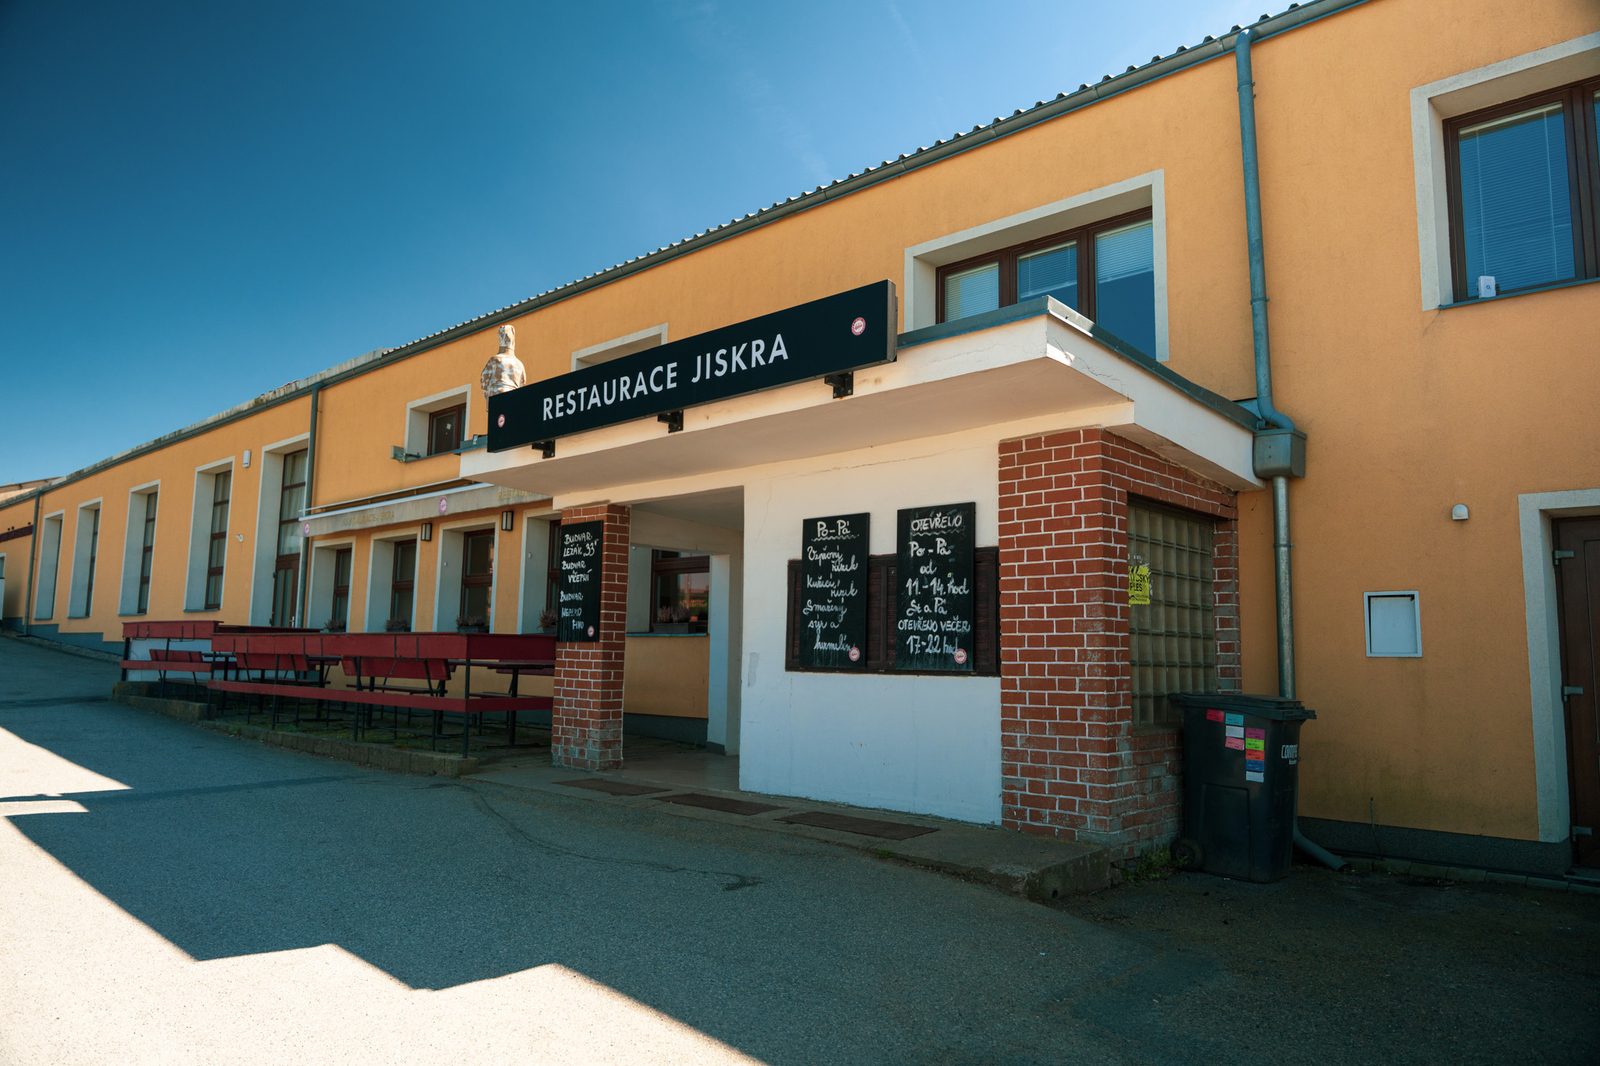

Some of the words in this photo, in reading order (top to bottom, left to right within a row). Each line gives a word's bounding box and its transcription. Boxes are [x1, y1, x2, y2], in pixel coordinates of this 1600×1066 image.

[542, 362, 678, 422] RESTAURACE
[691, 333, 789, 383] JISKRA
[911, 512, 962, 531] OTEVŘENO
[919, 559, 937, 574] od
[923, 604, 932, 613] a
[940, 615, 971, 632] VEČER
